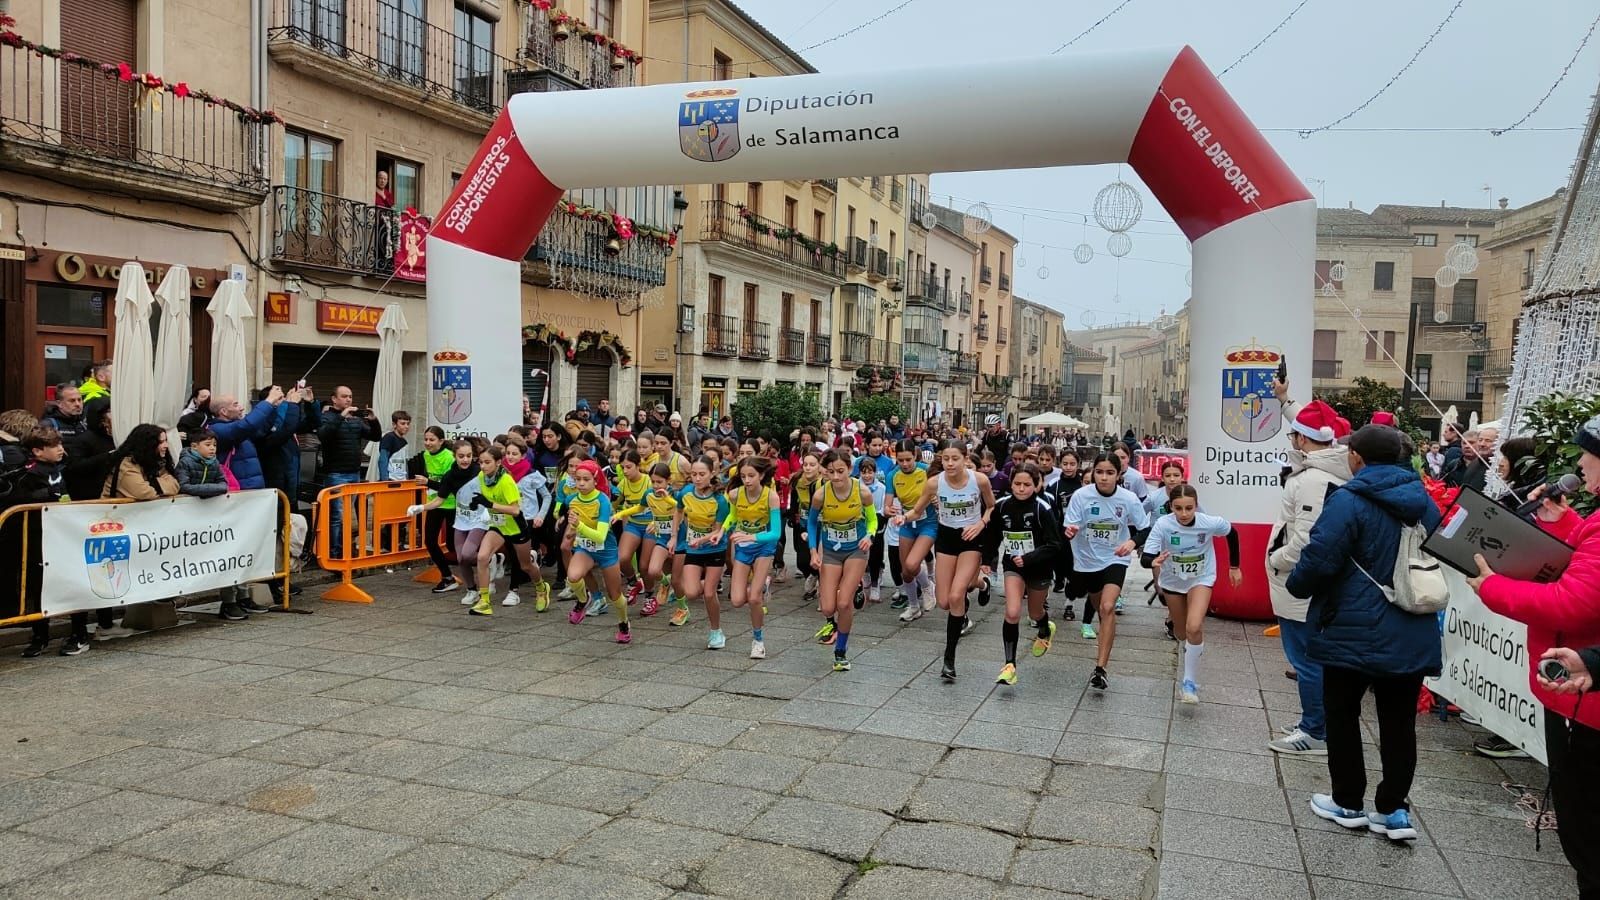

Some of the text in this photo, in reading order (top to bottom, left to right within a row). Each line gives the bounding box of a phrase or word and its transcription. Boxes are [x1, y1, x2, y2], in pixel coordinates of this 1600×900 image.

[746, 90, 873, 115] Diputación
[746, 126, 899, 147] de Salamanca
[1169, 97, 1260, 204] CON EL DEPORTE
[445, 135, 506, 229] CON NUESTROS
[454, 152, 510, 234] DEPORTISTAS
[446, 427, 488, 440] tación
[1206, 446, 1289, 466] Diputació
[1198, 469, 1279, 487] de Salama
[950, 508, 967, 517] 438
[137, 524, 235, 556] Diputación
[834, 530, 849, 539] 128
[1093, 530, 1111, 540] 382
[1009, 540, 1025, 551] 201
[137, 553, 254, 585] de Salamanca
[1180, 563, 1198, 574] 122
[1448, 607, 1524, 668] Diputación
[1461, 658, 1537, 729] Salamanca
